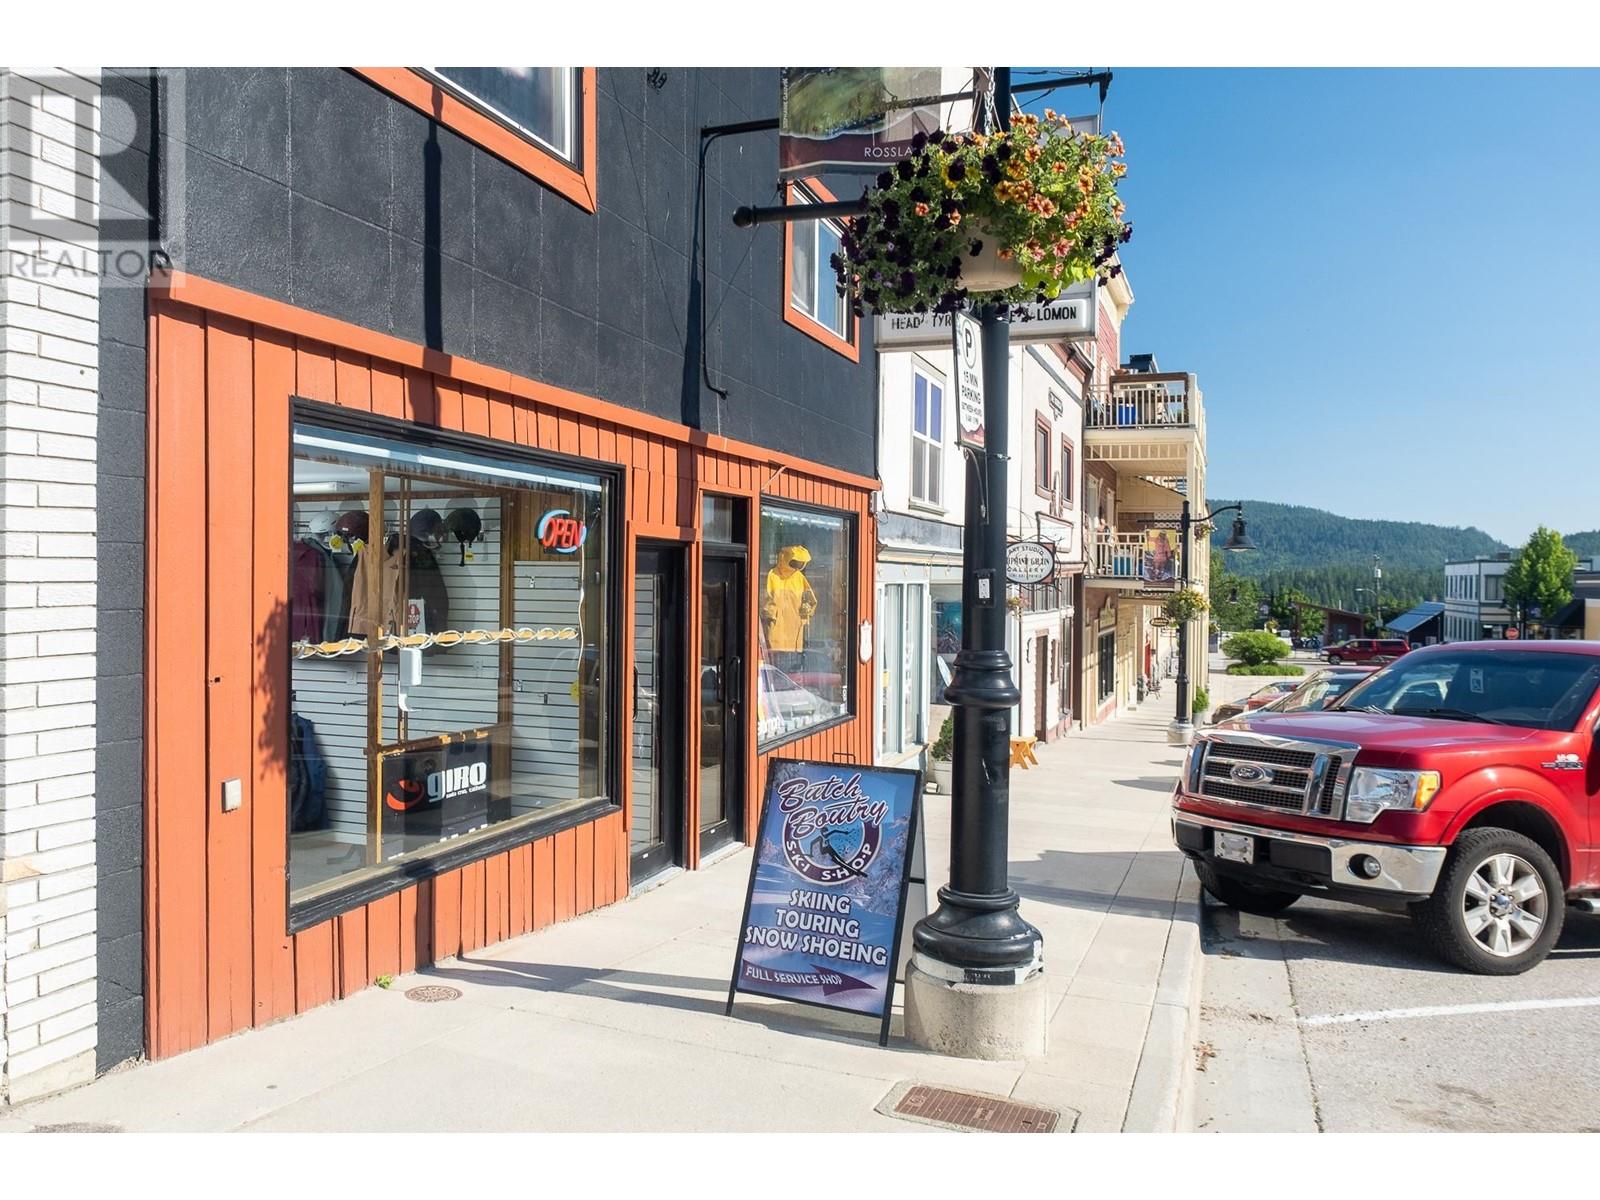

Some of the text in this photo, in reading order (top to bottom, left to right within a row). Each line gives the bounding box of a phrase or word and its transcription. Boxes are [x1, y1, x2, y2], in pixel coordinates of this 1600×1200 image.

[864, 146, 928, 158] ROSSLA
[1030, 306, 1077, 321] LOMON
[964, 328, 973, 357] P
[961, 385, 981, 405] PARKING
[542, 517, 584, 548] OPEN
[1008, 545, 1044, 556] ART STUDIO
[778, 773, 862, 813] Butch
[788, 796, 888, 839] Boutry
[789, 889, 851, 914] SKIING
[775, 908, 860, 939] TOURING
[744, 925, 887, 966] SNOW SHOEING
[745, 965, 843, 986] FULL SERVICE SHOP
